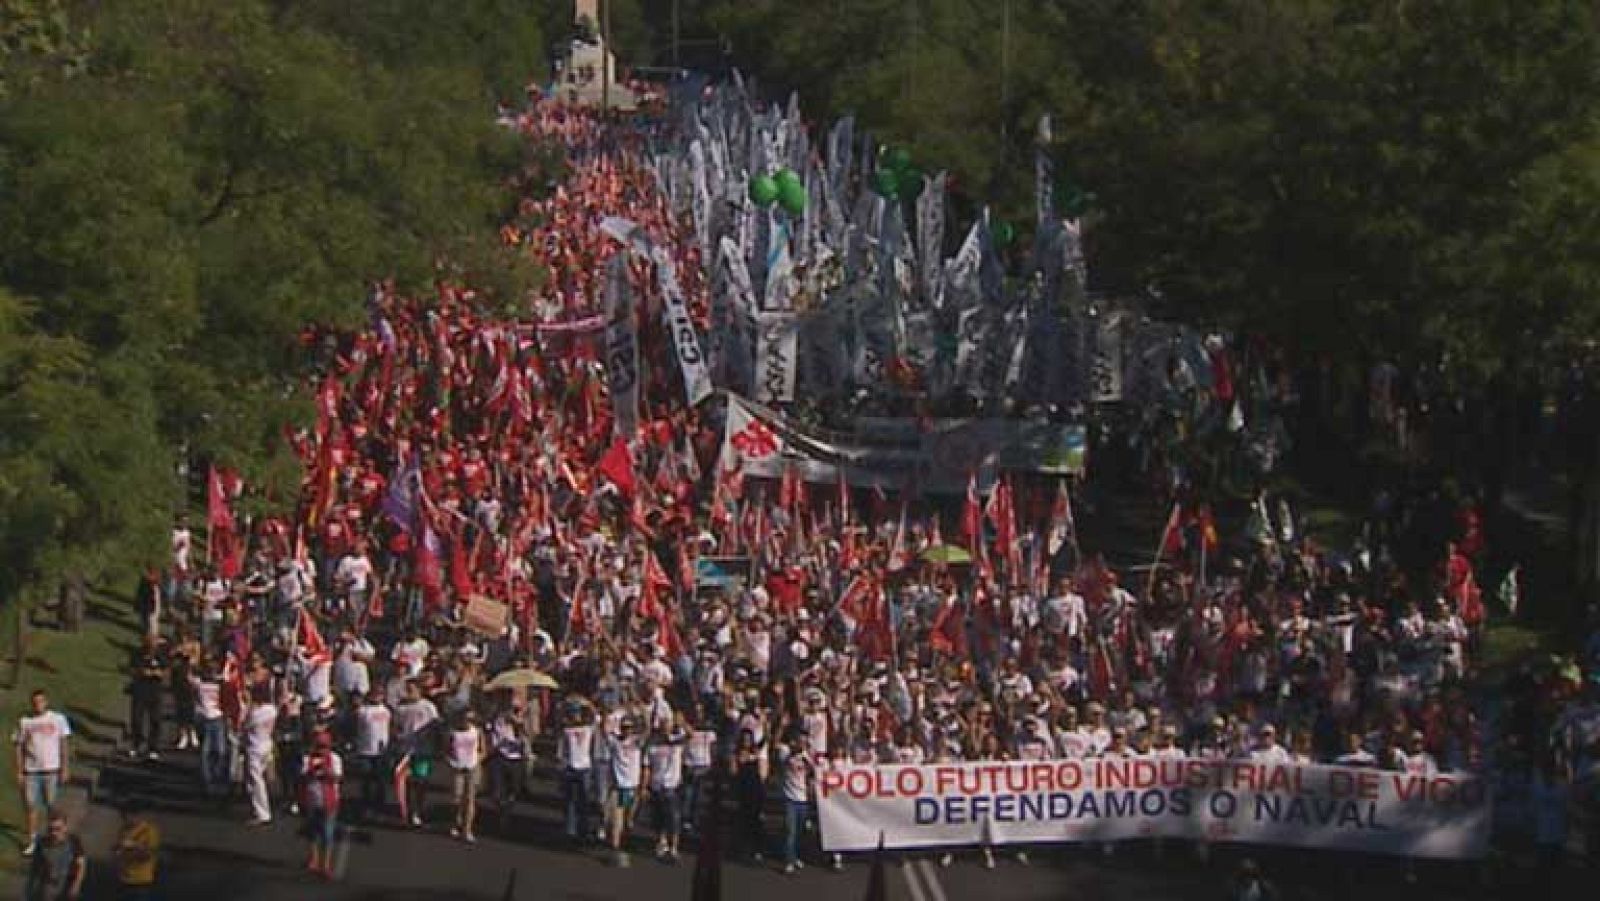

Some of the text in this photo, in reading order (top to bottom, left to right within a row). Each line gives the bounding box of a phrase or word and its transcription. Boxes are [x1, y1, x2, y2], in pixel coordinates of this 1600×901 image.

[821, 767, 924, 799] POLO
[934, 762, 1083, 794] FUTURO
[1095, 758, 1314, 796] INDUSTRIAL
[1329, 770, 1380, 800] DE
[915, 789, 1392, 830] DEFENDAMOS O NAVAL
